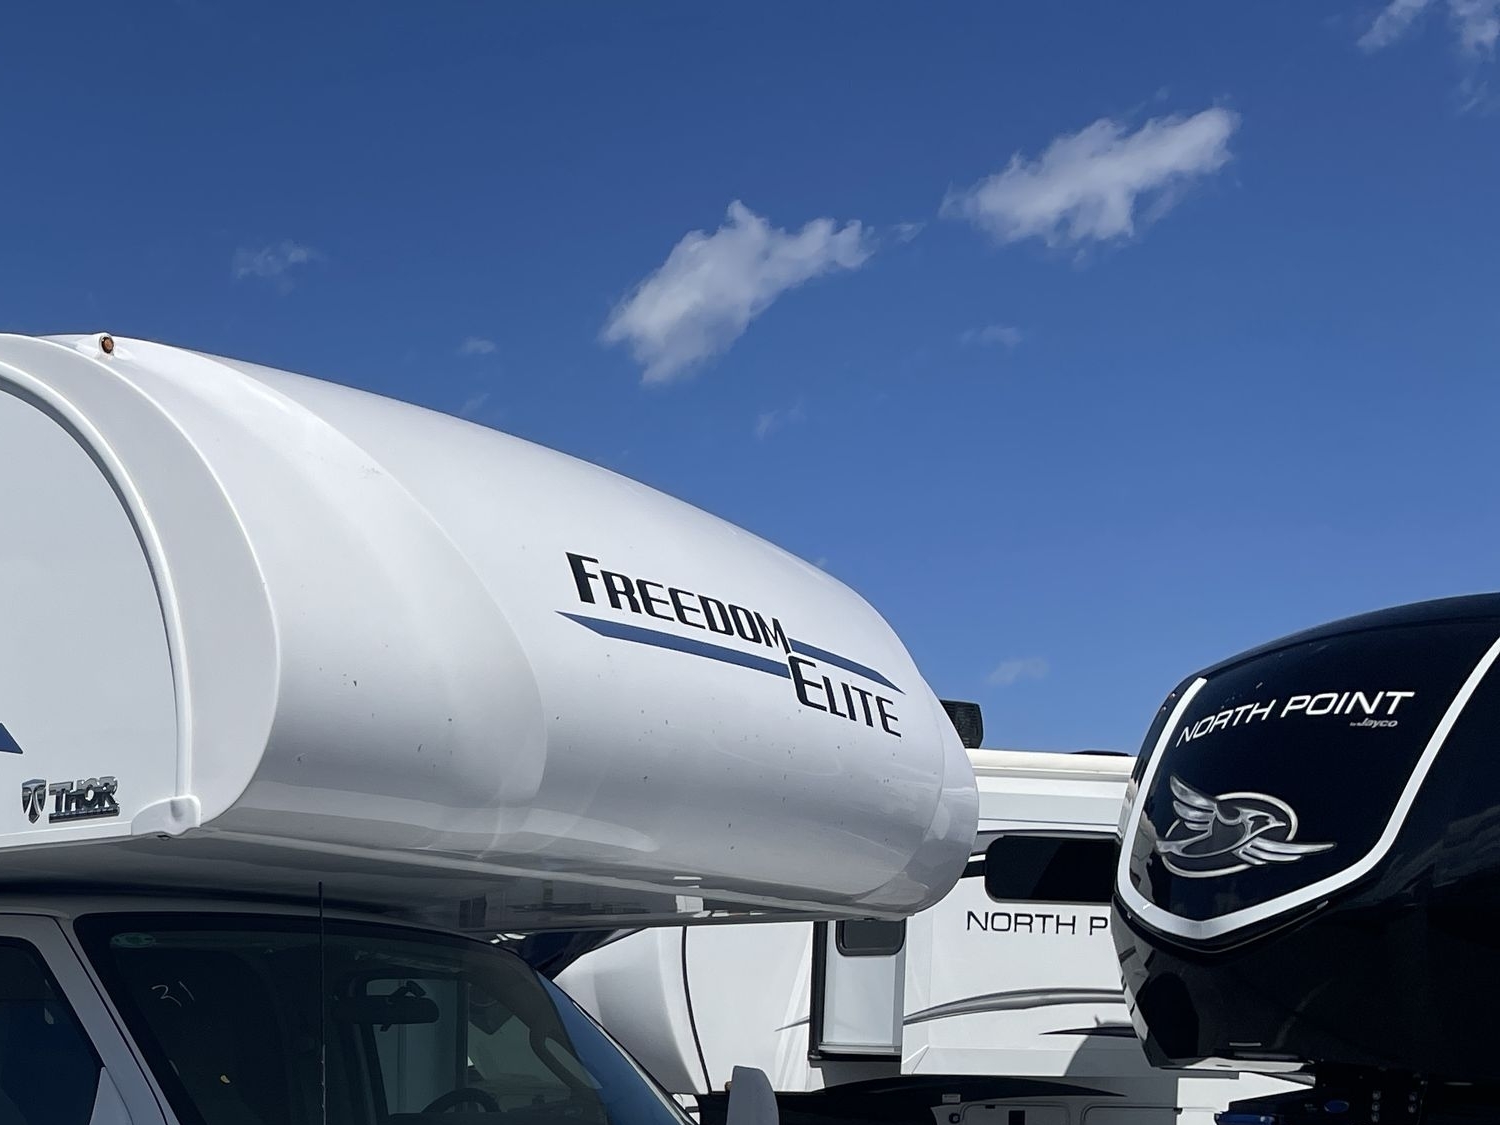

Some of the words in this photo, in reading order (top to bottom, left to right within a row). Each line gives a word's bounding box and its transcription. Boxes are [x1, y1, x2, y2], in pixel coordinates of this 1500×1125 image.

[565, 551, 791, 655] FREEDOM
[788, 654, 902, 738] ELITE
[1175, 699, 1277, 748] NORTH
[1280, 691, 1415, 719] POINT
[48, 776, 119, 815] THOR
[966, 910, 1076, 935] NORTH
